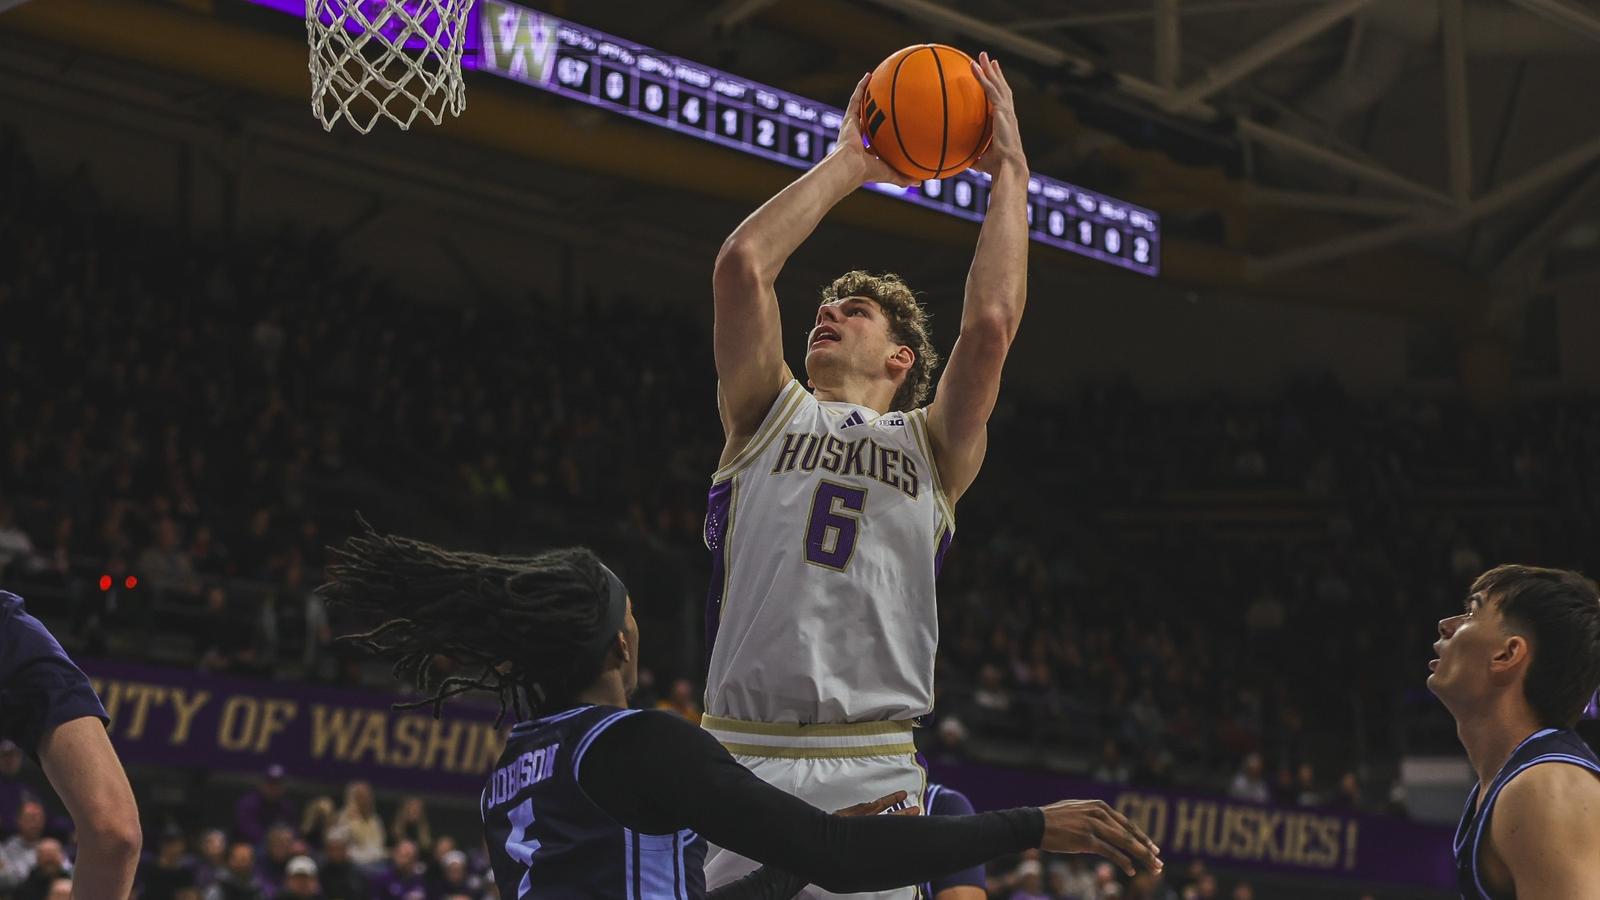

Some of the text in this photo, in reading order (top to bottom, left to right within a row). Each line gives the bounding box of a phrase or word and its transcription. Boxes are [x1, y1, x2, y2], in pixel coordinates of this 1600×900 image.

[480, 0, 558, 86] W
[682, 96, 700, 124] 4
[722, 108, 738, 136] 1
[756, 119, 775, 147] 2
[794, 131, 809, 158] 1
[1078, 220, 1093, 245] 1
[769, 432, 920, 501] HUSKIES
[802, 478, 869, 573] 6
[93, 679, 210, 744] ITY
[217, 697, 297, 753] OF
